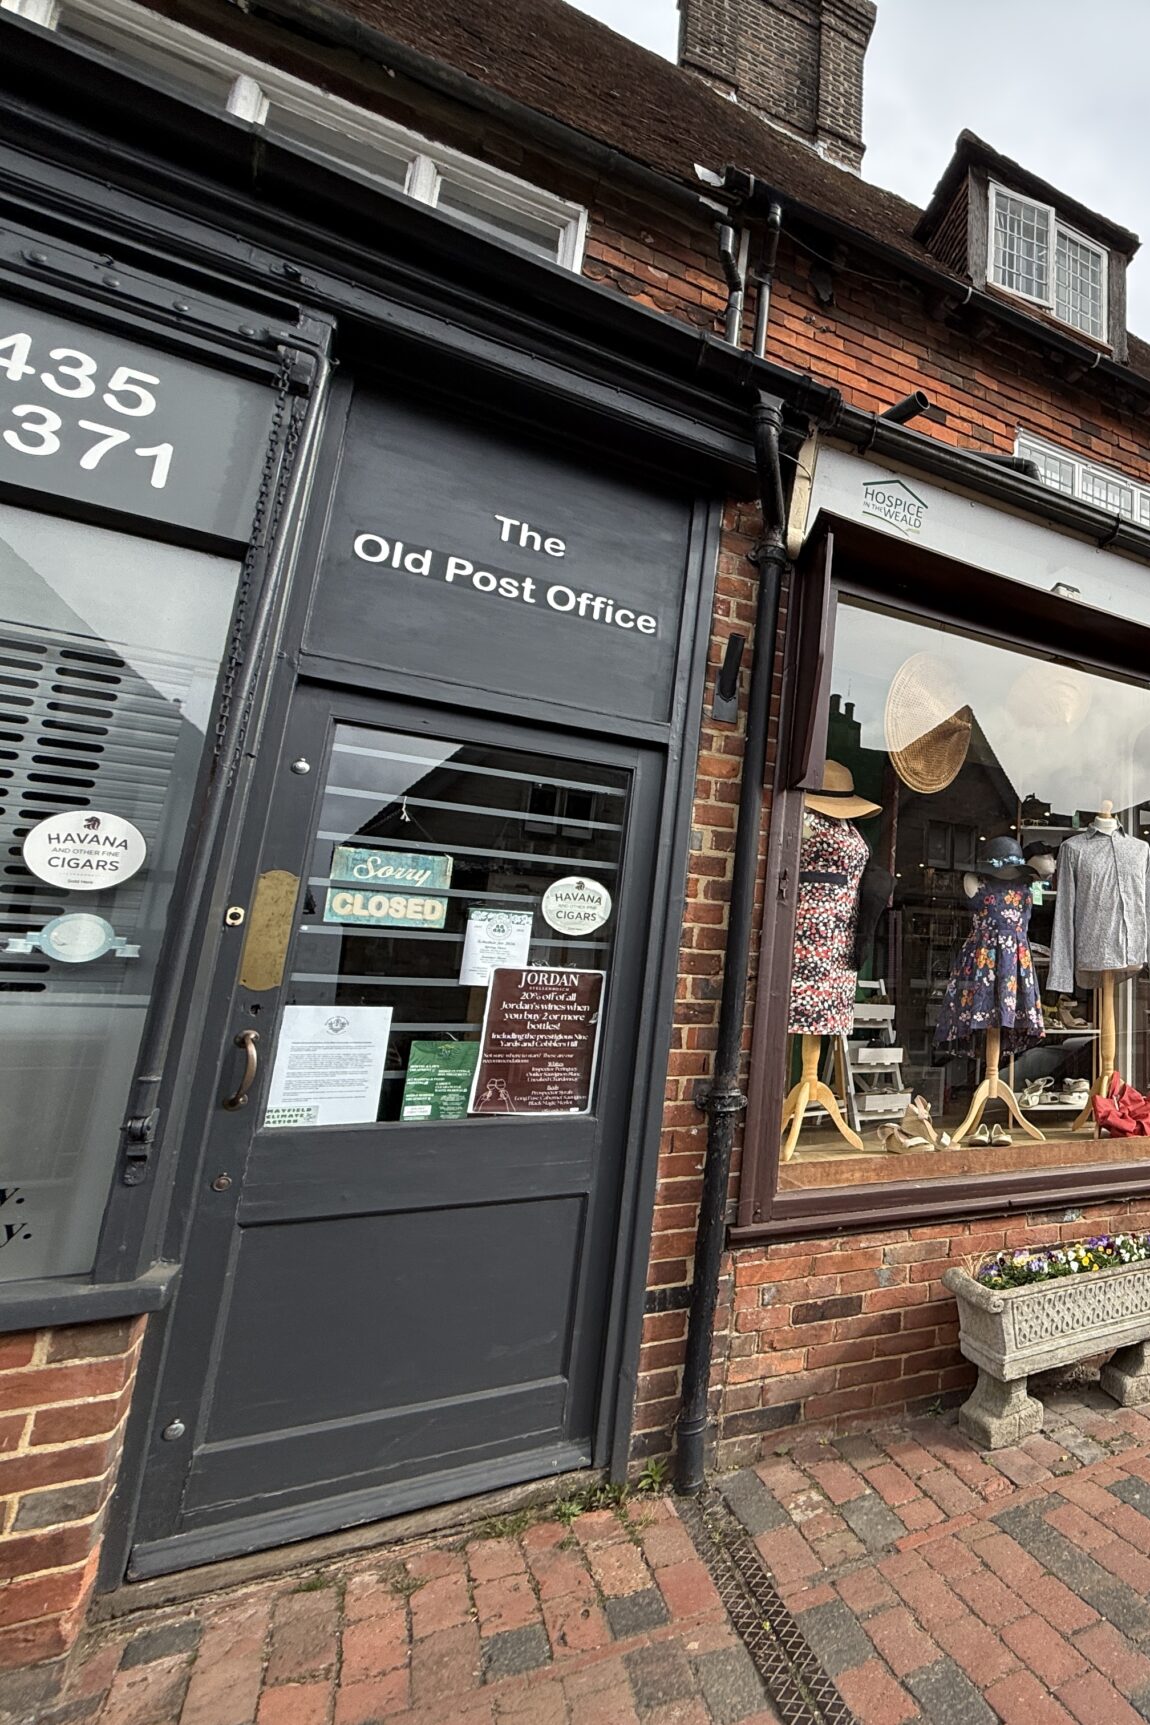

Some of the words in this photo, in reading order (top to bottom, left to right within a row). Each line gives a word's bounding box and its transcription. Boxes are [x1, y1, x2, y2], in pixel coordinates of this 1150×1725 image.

[3, 404, 174, 489] 371
[864, 487, 924, 519] HOSPICE
[872, 504, 883, 513] THE
[884, 507, 921, 529] WEALD
[495, 514, 566, 557] The
[353, 533, 432, 576] Old
[445, 556, 536, 603] Post
[546, 585, 657, 634] Office
[47, 832, 129, 850] HAVANA
[72, 848, 100, 856] OTHER
[47, 856, 120, 872] CIGARS
[353, 856, 431, 887] Sorry
[332, 892, 444, 920] CLOSED
[555, 892, 602, 905] HAVANA
[555, 910, 597, 921] CIGARS
[518, 972, 580, 988] JORDAN
[520, 991, 541, 1000] 20%
[542, 992, 554, 1001] off
[556, 992, 566, 1001] of
[566, 993, 576, 1001] all
[500, 1001, 540, 1010] Jordan's
[541, 1002, 566, 1010] wines
[567, 1003, 590, 1011] when
[524, 1012, 540, 1021] buy
[542, 1012, 548, 1020] 2
[527, 1021, 561, 1030] bottles!
[491, 1032, 524, 1041] Including
[536, 1033, 573, 1041] prestigious
